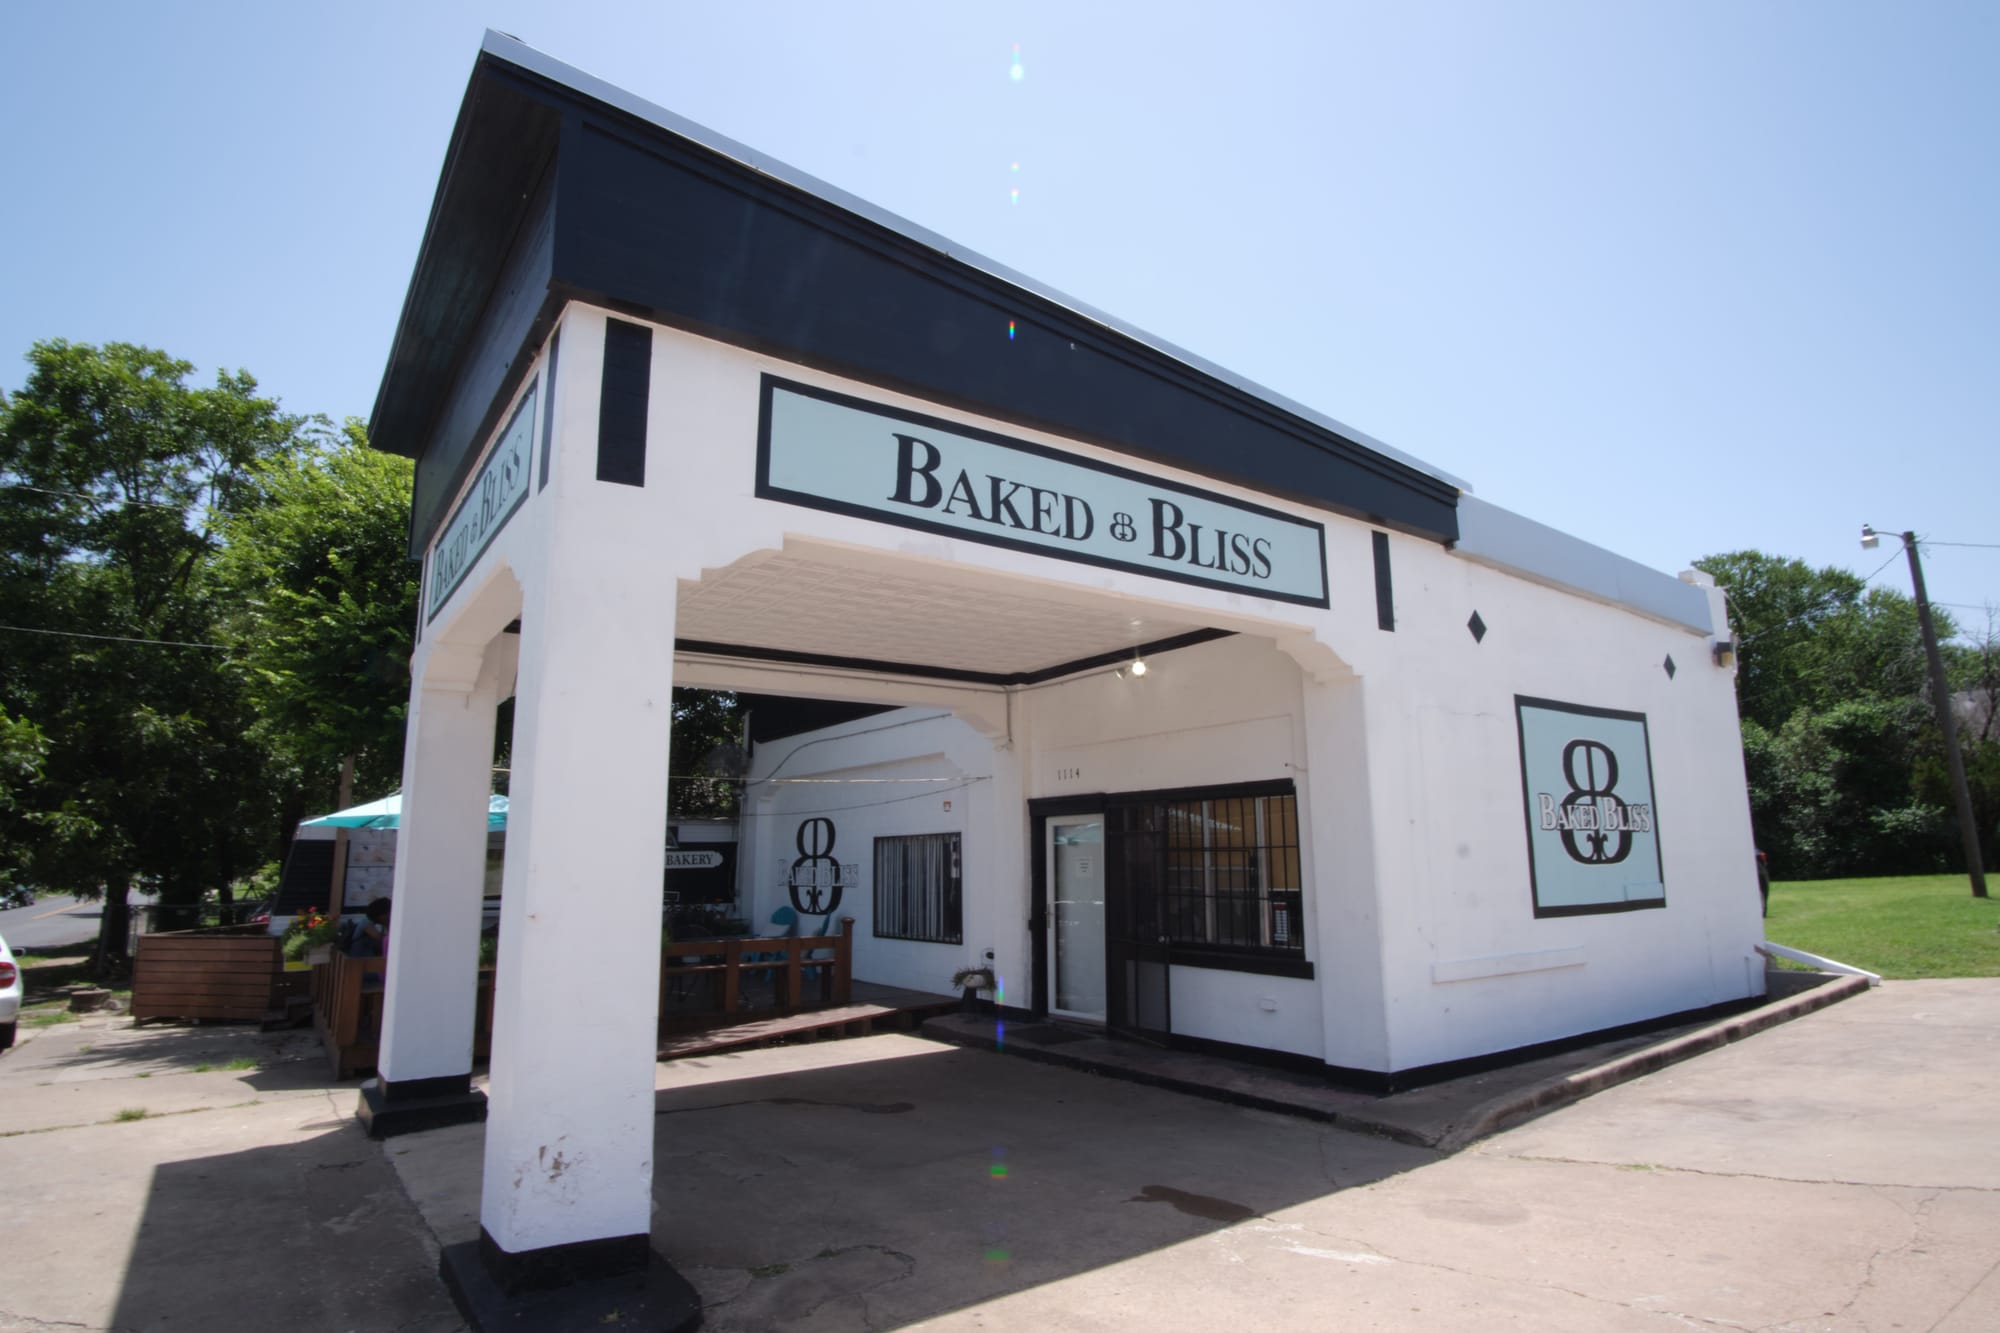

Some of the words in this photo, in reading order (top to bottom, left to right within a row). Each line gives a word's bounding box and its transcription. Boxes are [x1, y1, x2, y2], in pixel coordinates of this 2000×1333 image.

[887, 433, 1094, 541] BAKED
[1148, 498, 1272, 579] BLISS
[1057, 768, 1080, 781] 1114
[1538, 793, 1600, 830] BAKED
[1603, 797, 1650, 832] BLISS
[666, 854, 713, 865] BAKERY
